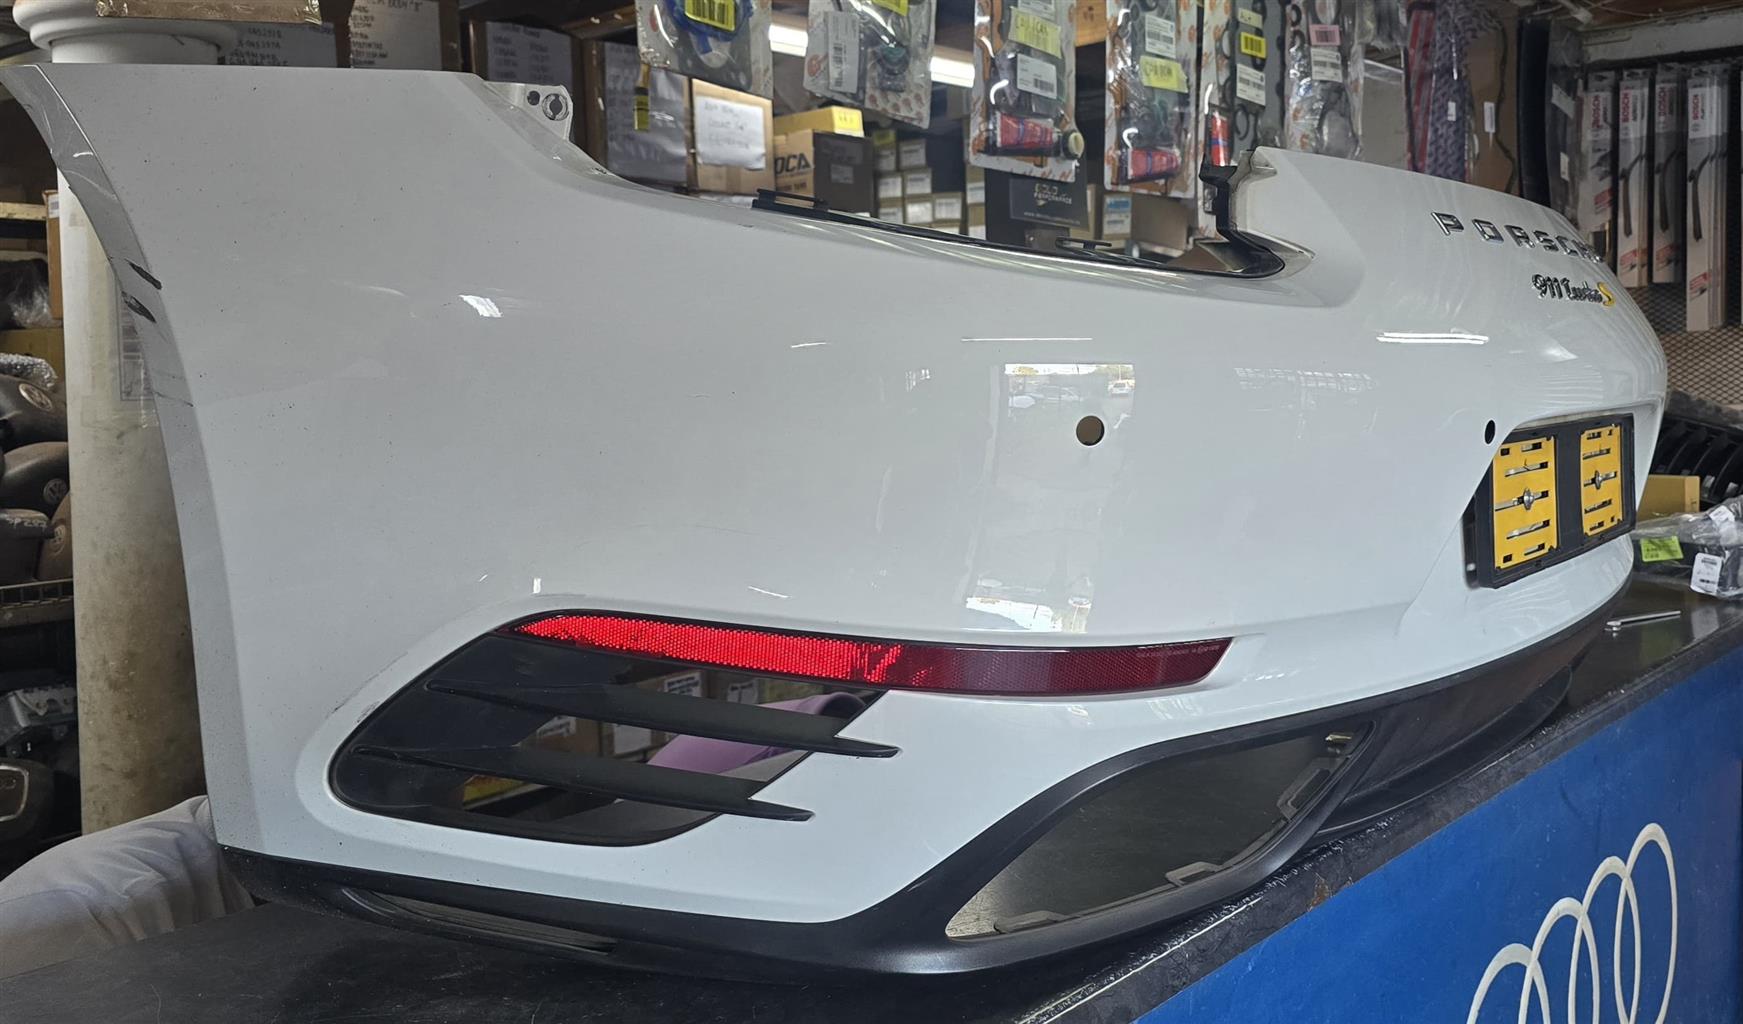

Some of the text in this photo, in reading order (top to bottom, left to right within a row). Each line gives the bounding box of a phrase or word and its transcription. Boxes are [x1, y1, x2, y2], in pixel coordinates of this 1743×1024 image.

[1621, 92, 1630, 123] BOSCH
[1692, 93, 1700, 121] BOSCH
[1532, 273, 1563, 299] 911
